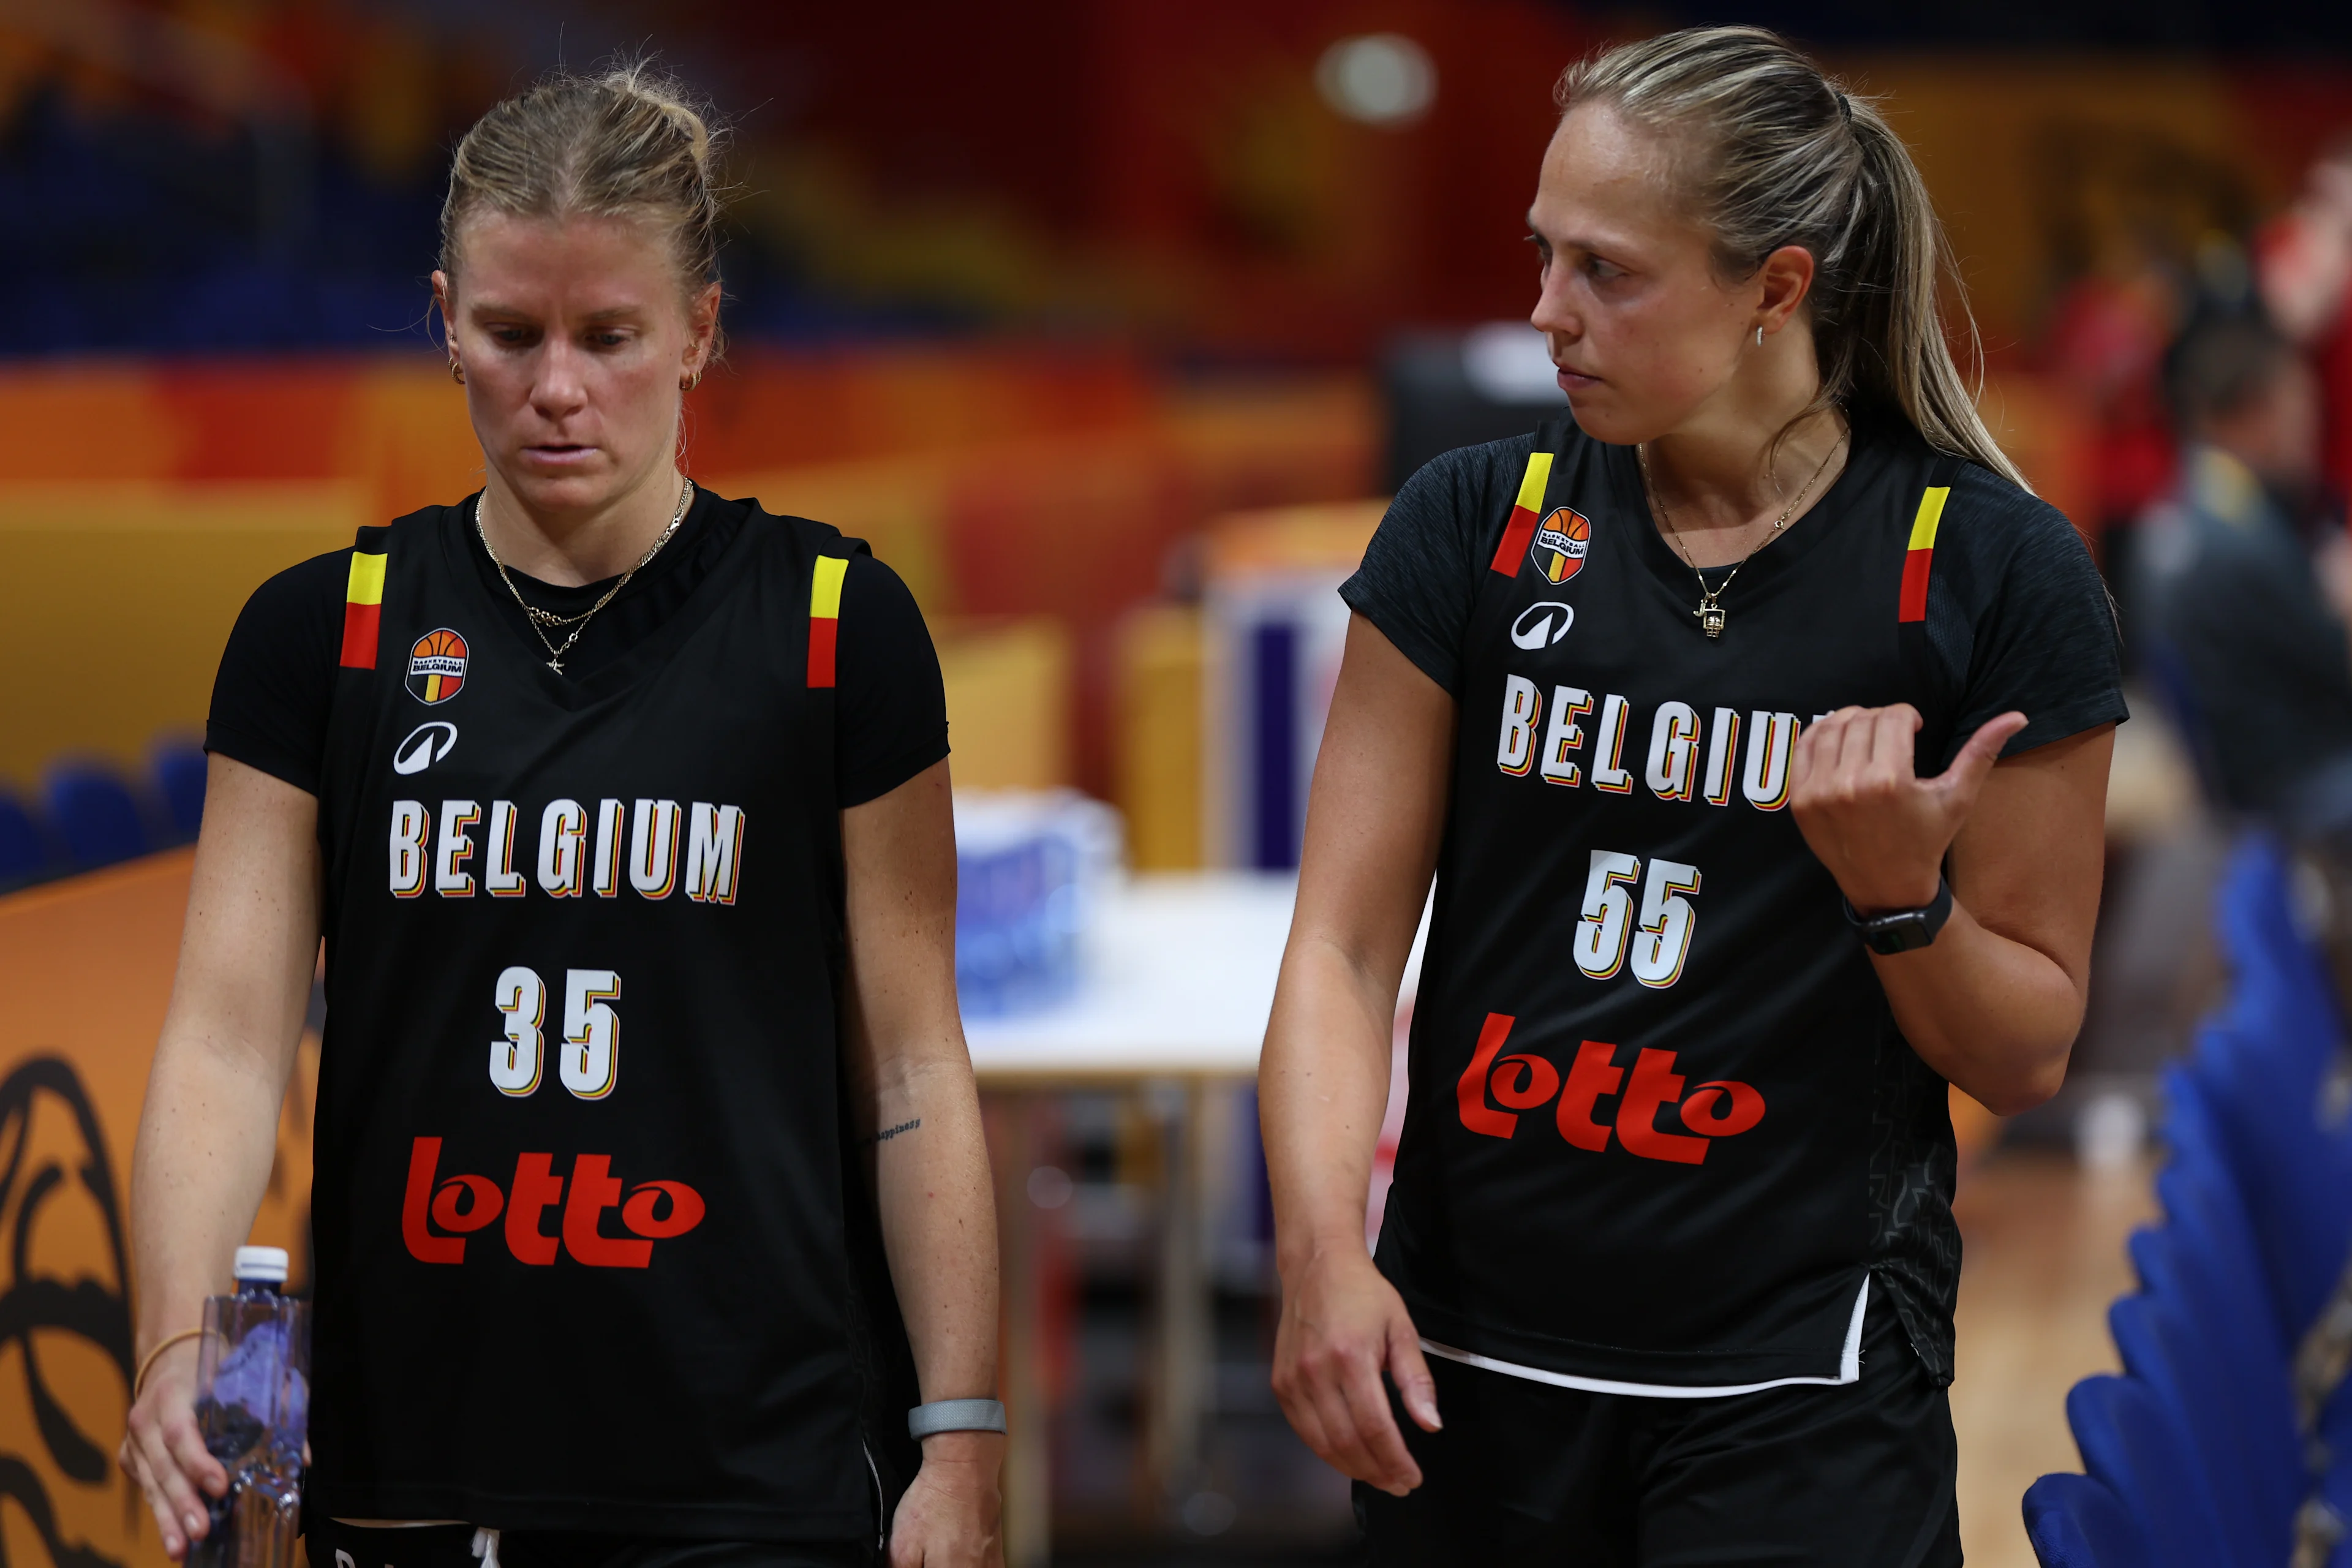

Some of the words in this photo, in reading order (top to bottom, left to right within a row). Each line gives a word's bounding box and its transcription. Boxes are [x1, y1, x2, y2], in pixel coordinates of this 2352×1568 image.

[1540, 536, 1584, 555] BELGIUM
[1542, 532, 1585, 548] BASKETBALL
[412, 663, 462, 673] BELGIUM
[1497, 674, 1836, 812] BELGIU
[390, 799, 745, 906] BELGIUM
[1573, 850, 1702, 989] 55
[489, 966, 622, 1101] 35
[1457, 1012, 1766, 1165] lotto
[402, 1137, 706, 1268] lotto
